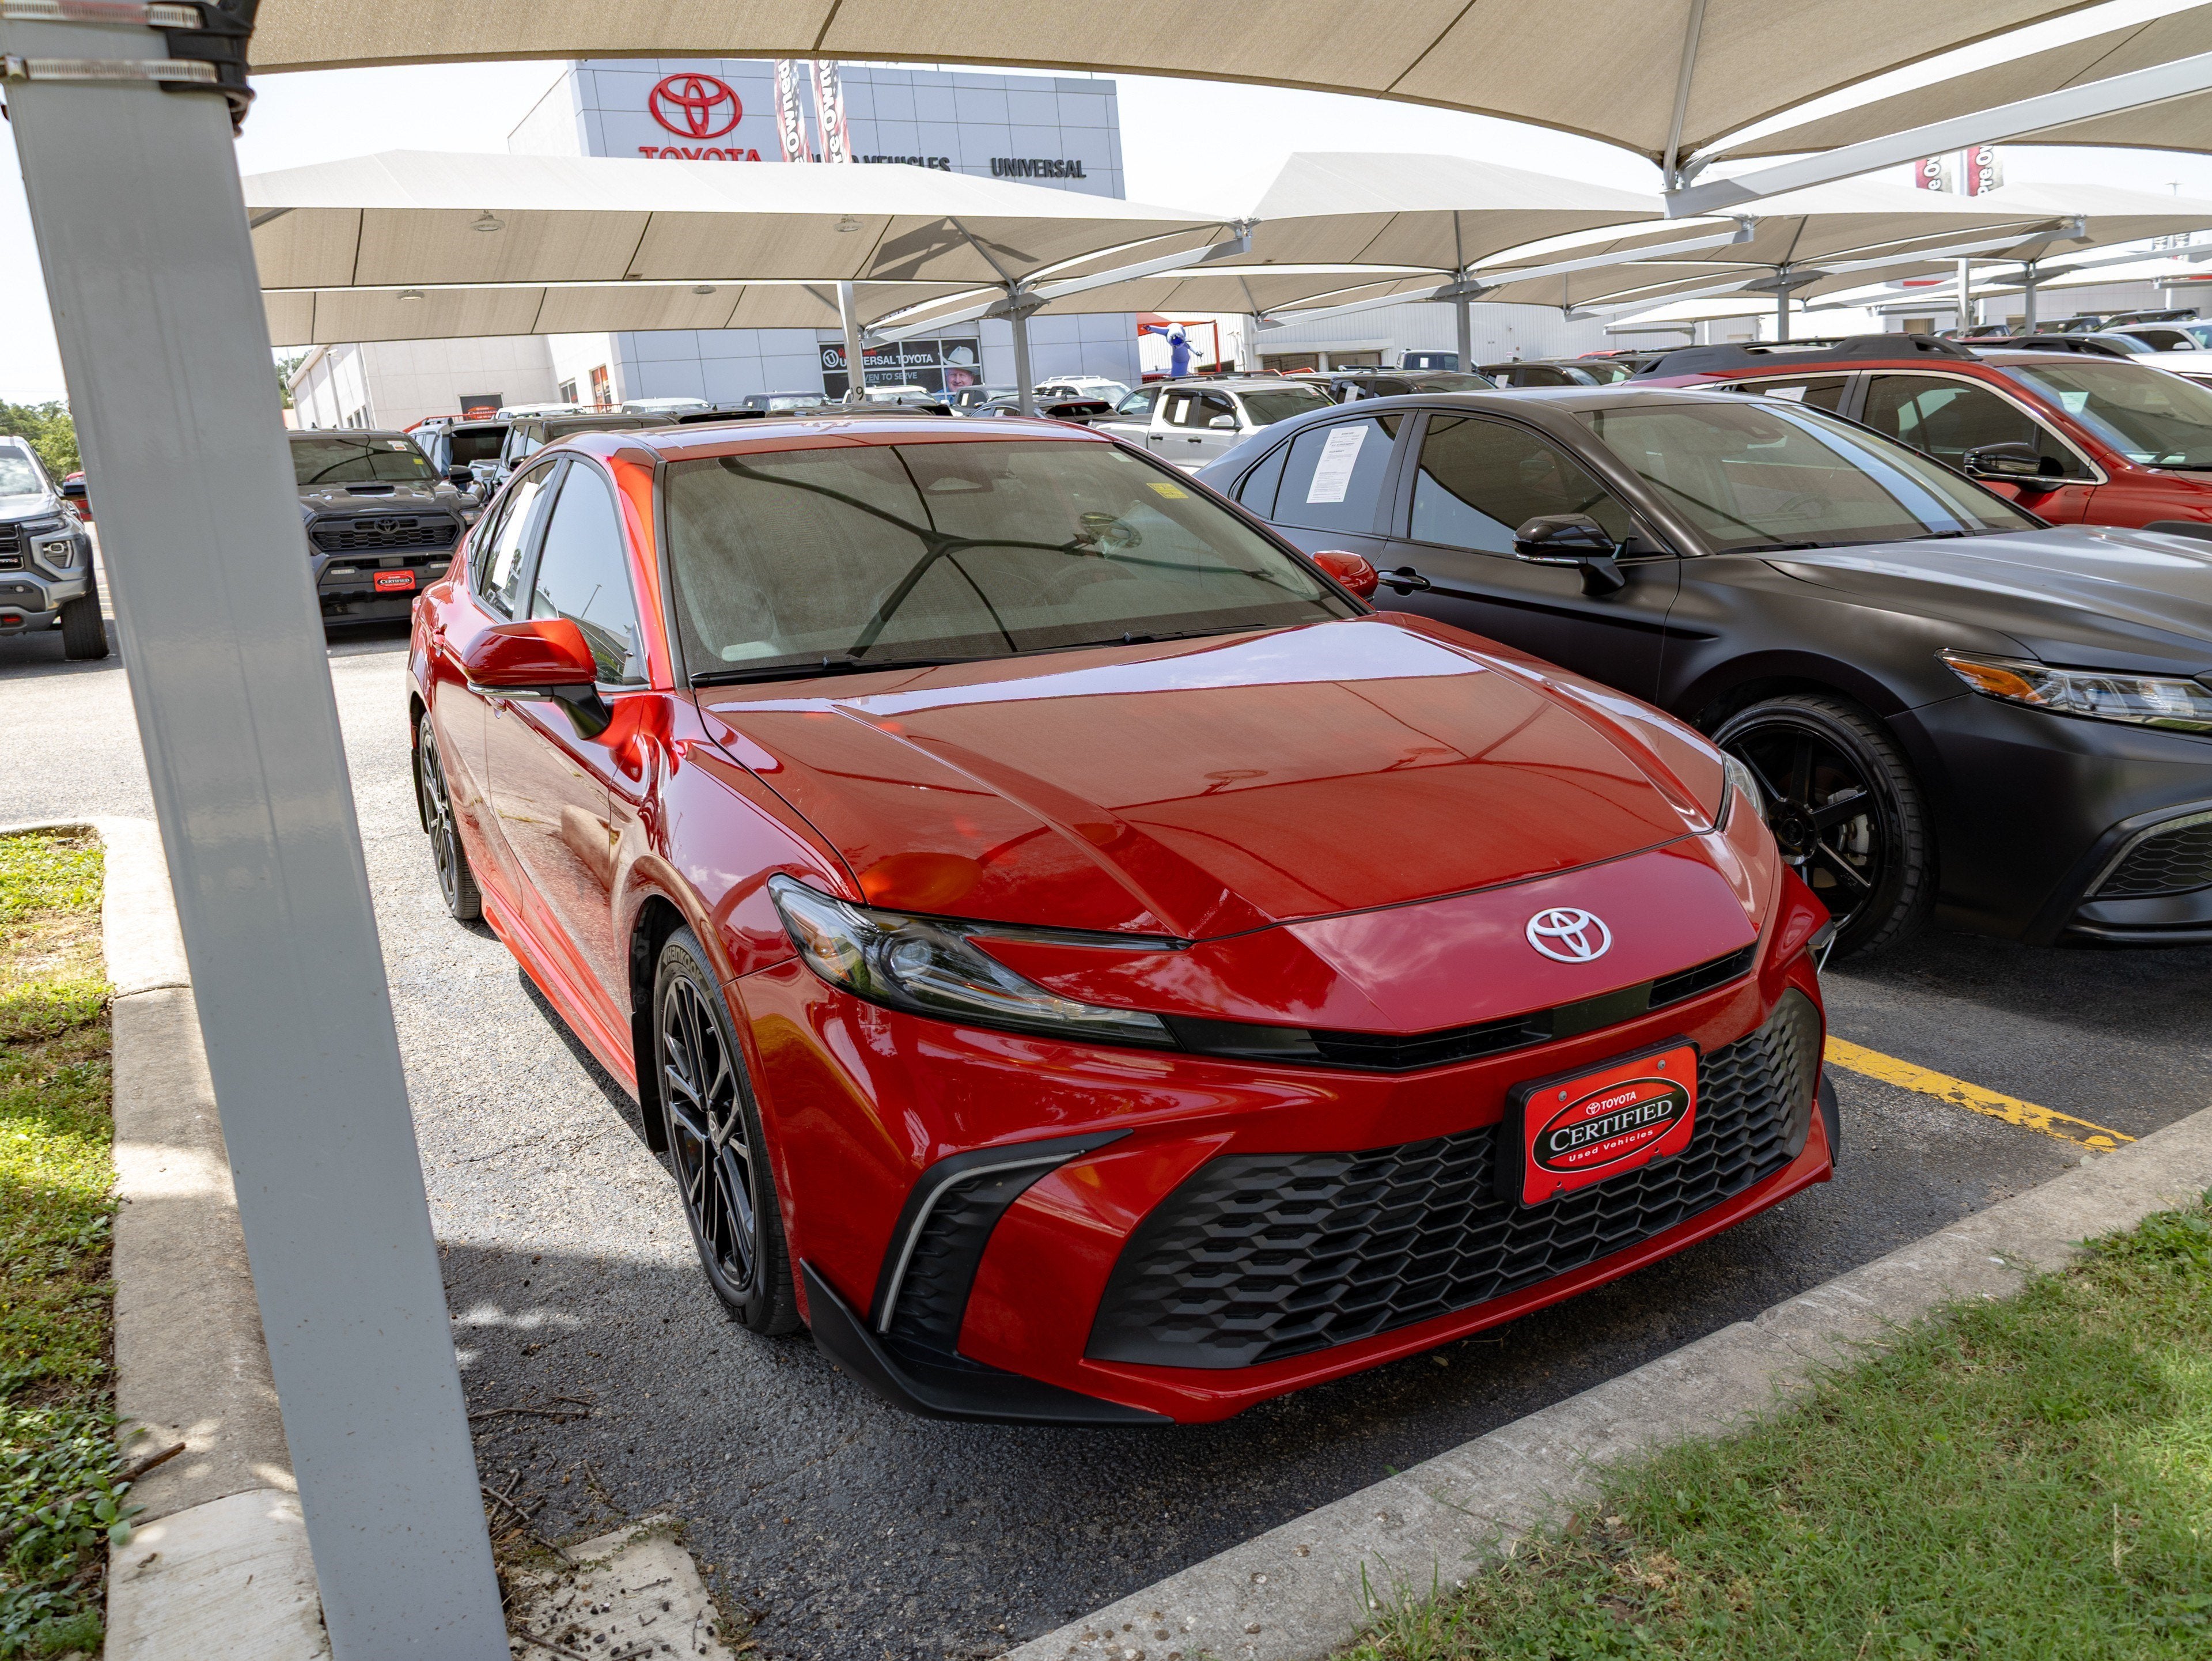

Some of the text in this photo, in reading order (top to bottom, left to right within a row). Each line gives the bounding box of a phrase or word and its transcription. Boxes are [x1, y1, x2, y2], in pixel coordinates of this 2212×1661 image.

[778, 59, 800, 153] Owned
[819, 60, 836, 131] Owne
[991, 157, 1087, 178] UNIVERSAL
[839, 354, 934, 367] UERSAL TOYOTA
[856, 386, 864, 401] 9
[1601, 1091, 1637, 1110] TOYOTA
[1550, 1100, 1673, 1151] CERTIFIED
[1569, 1130, 1653, 1162] Used Vehicles
